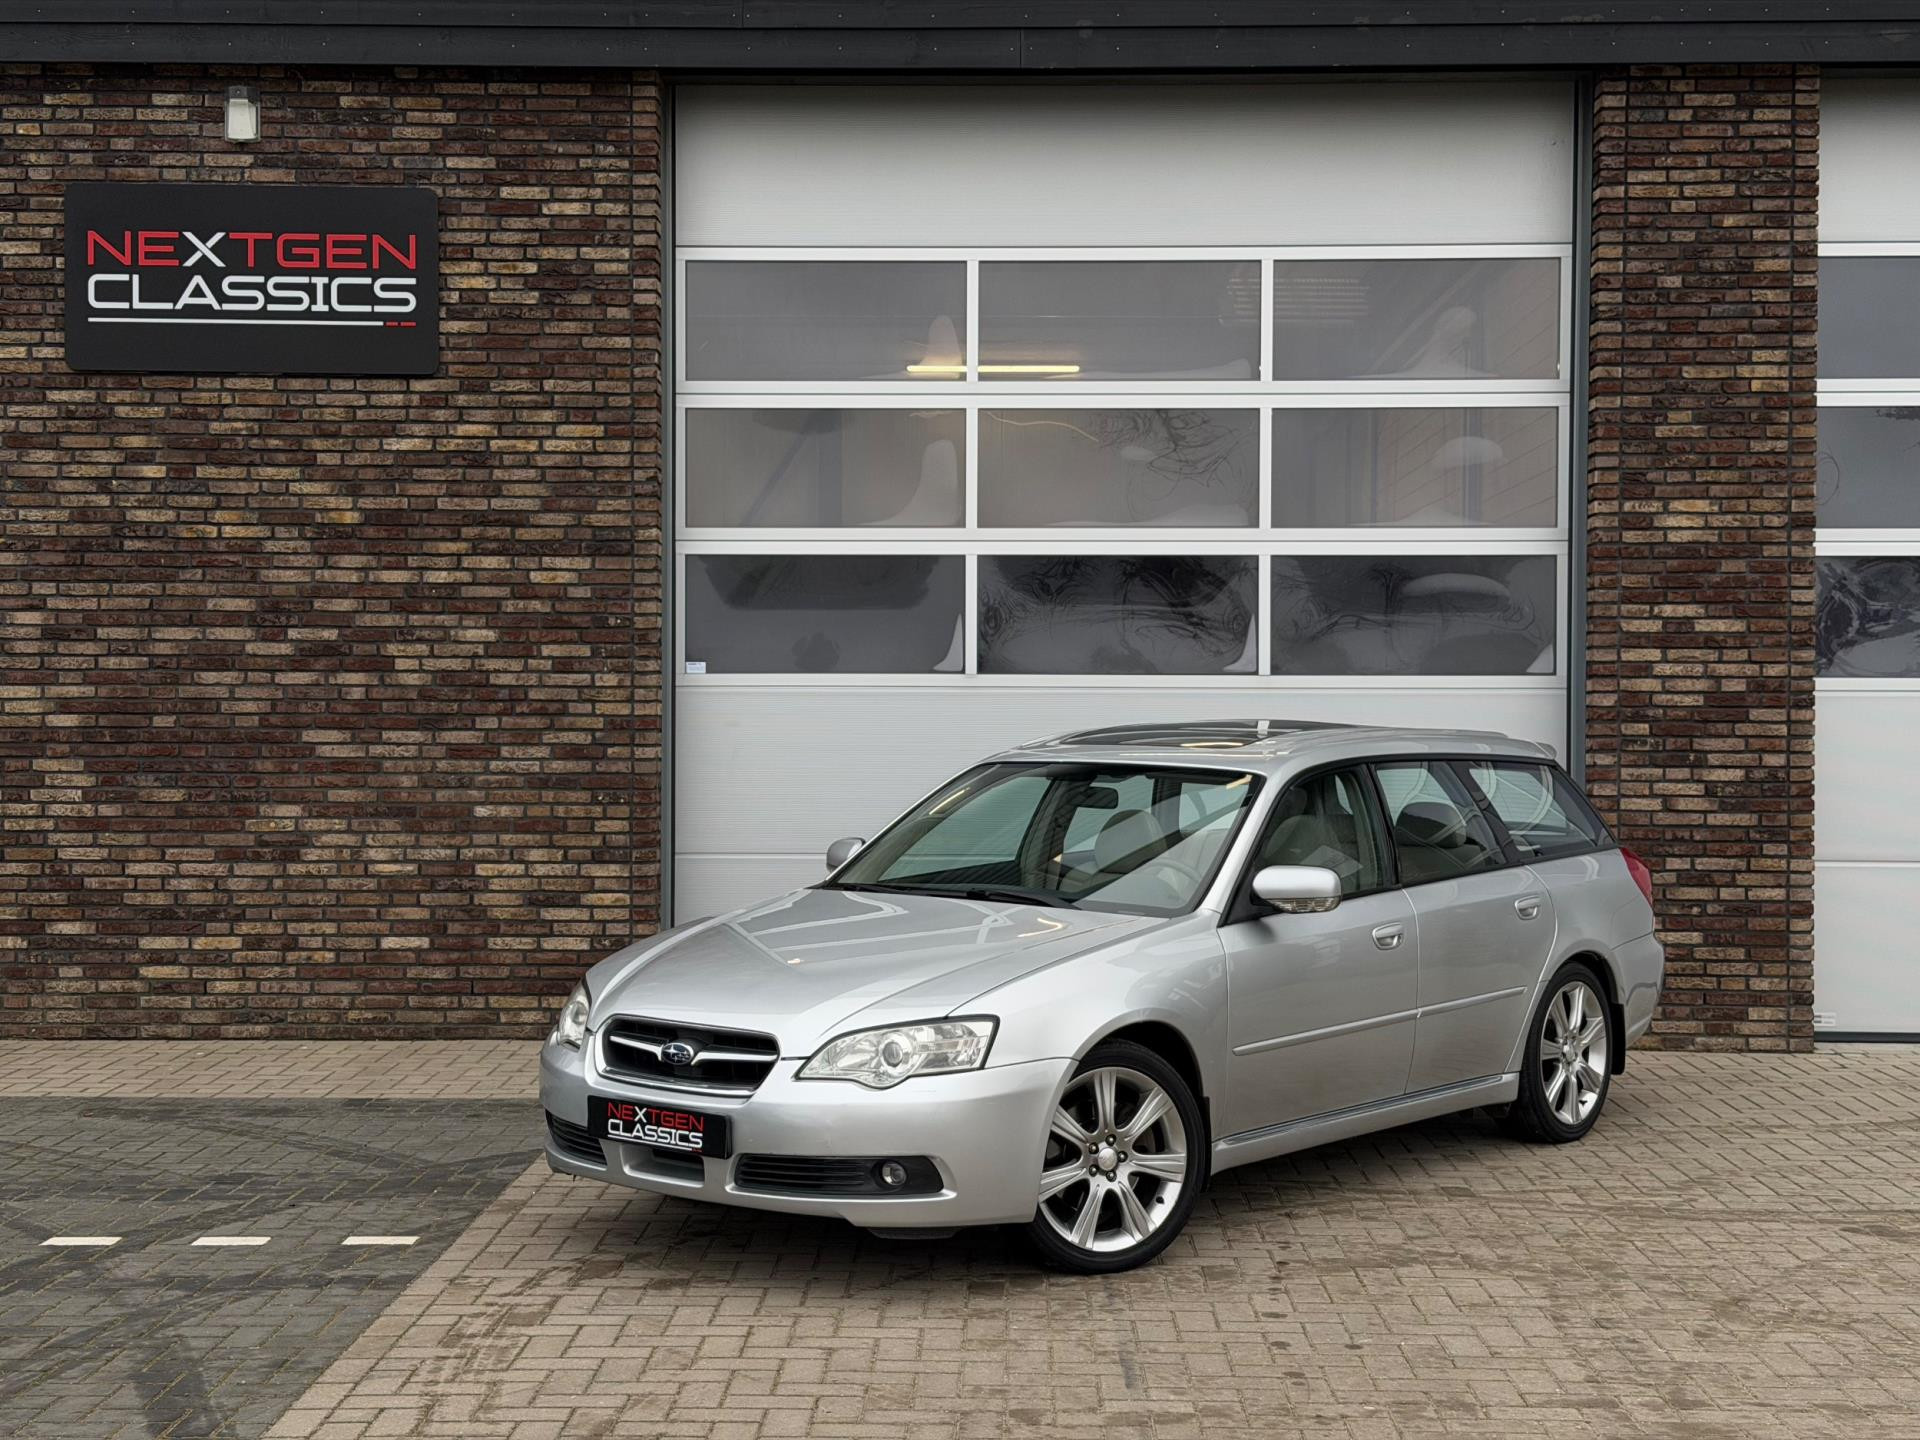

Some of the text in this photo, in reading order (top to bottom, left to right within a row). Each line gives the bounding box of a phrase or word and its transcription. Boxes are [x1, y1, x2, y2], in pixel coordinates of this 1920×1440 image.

[87, 230, 416, 269] NEXTGEN
[87, 273, 416, 312] CLASSICS
[607, 1101, 704, 1131] NEXTGEN
[607, 1118, 703, 1148] CLASSICS
